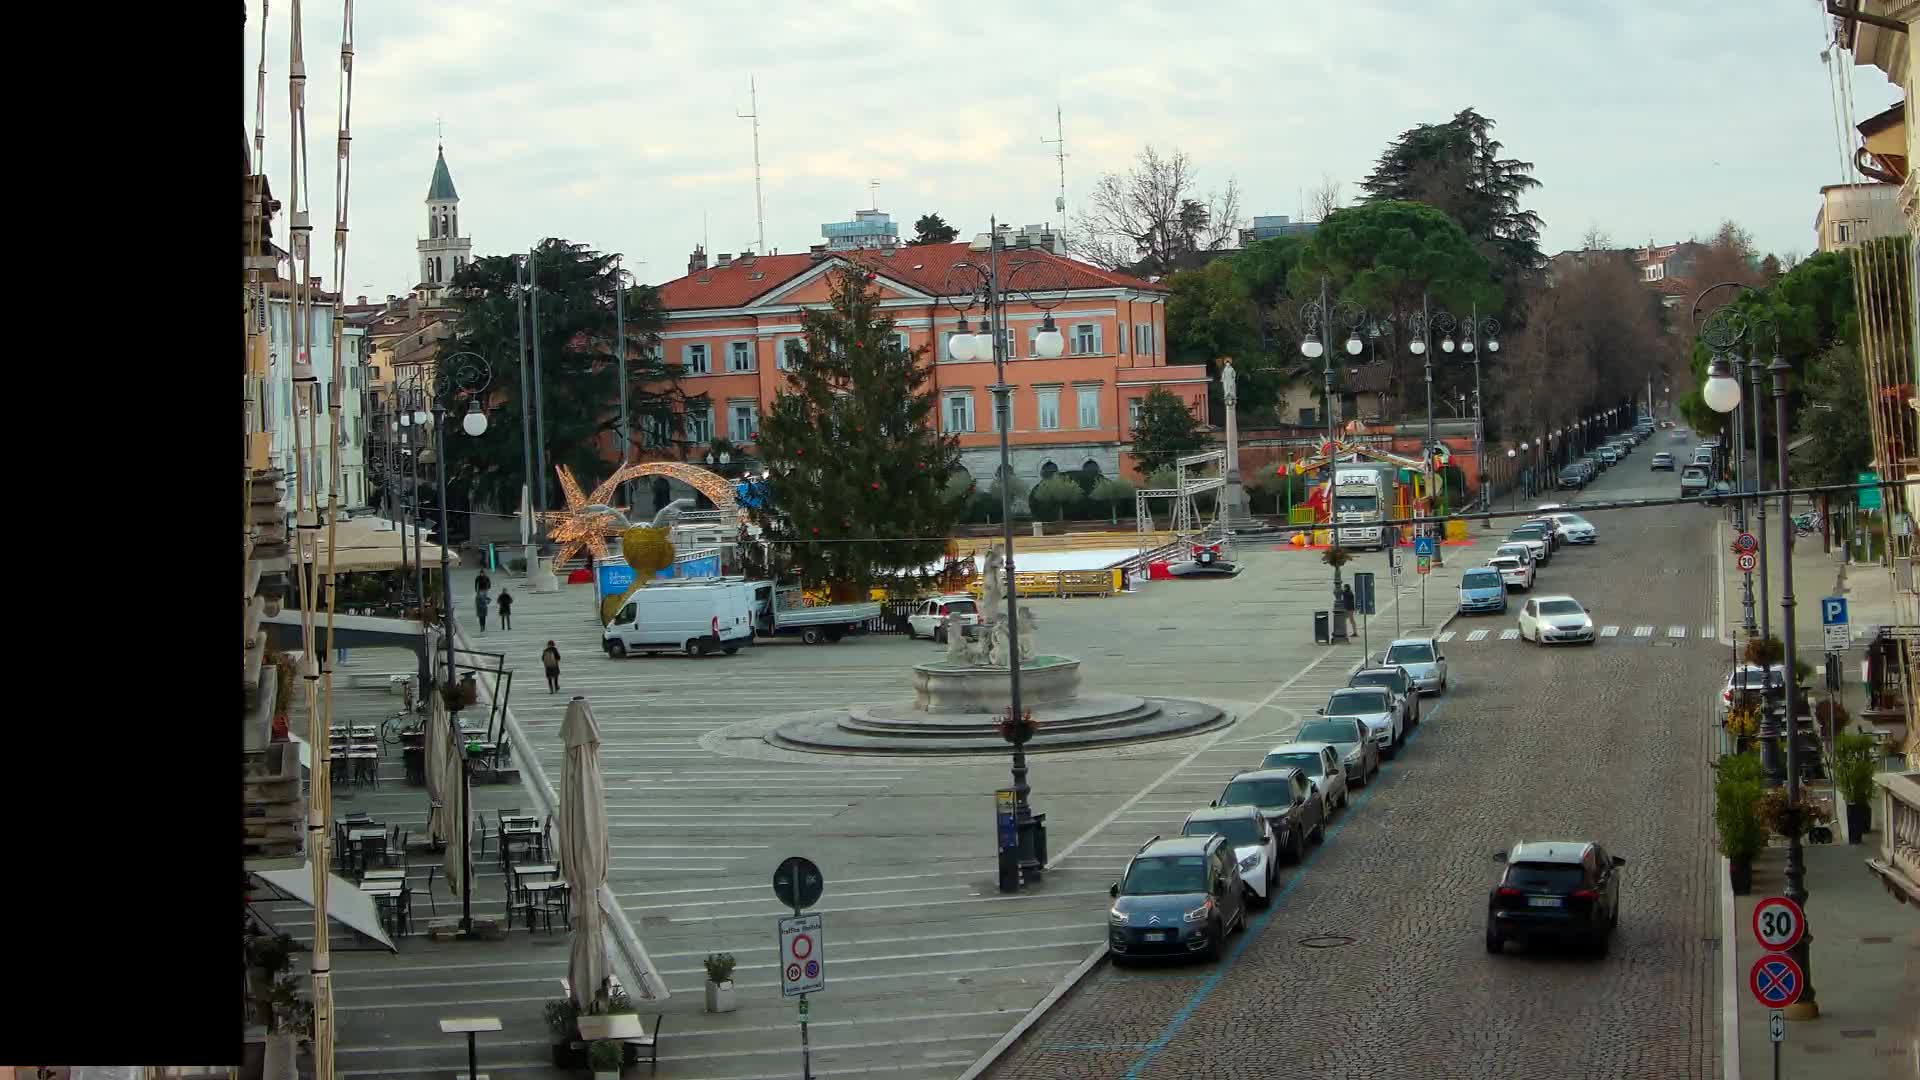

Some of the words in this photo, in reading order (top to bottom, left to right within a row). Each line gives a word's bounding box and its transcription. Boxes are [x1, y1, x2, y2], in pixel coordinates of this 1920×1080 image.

[1742, 557, 1753, 567] 20
[1827, 602, 1842, 621] P
[1762, 911, 1792, 937] 30
